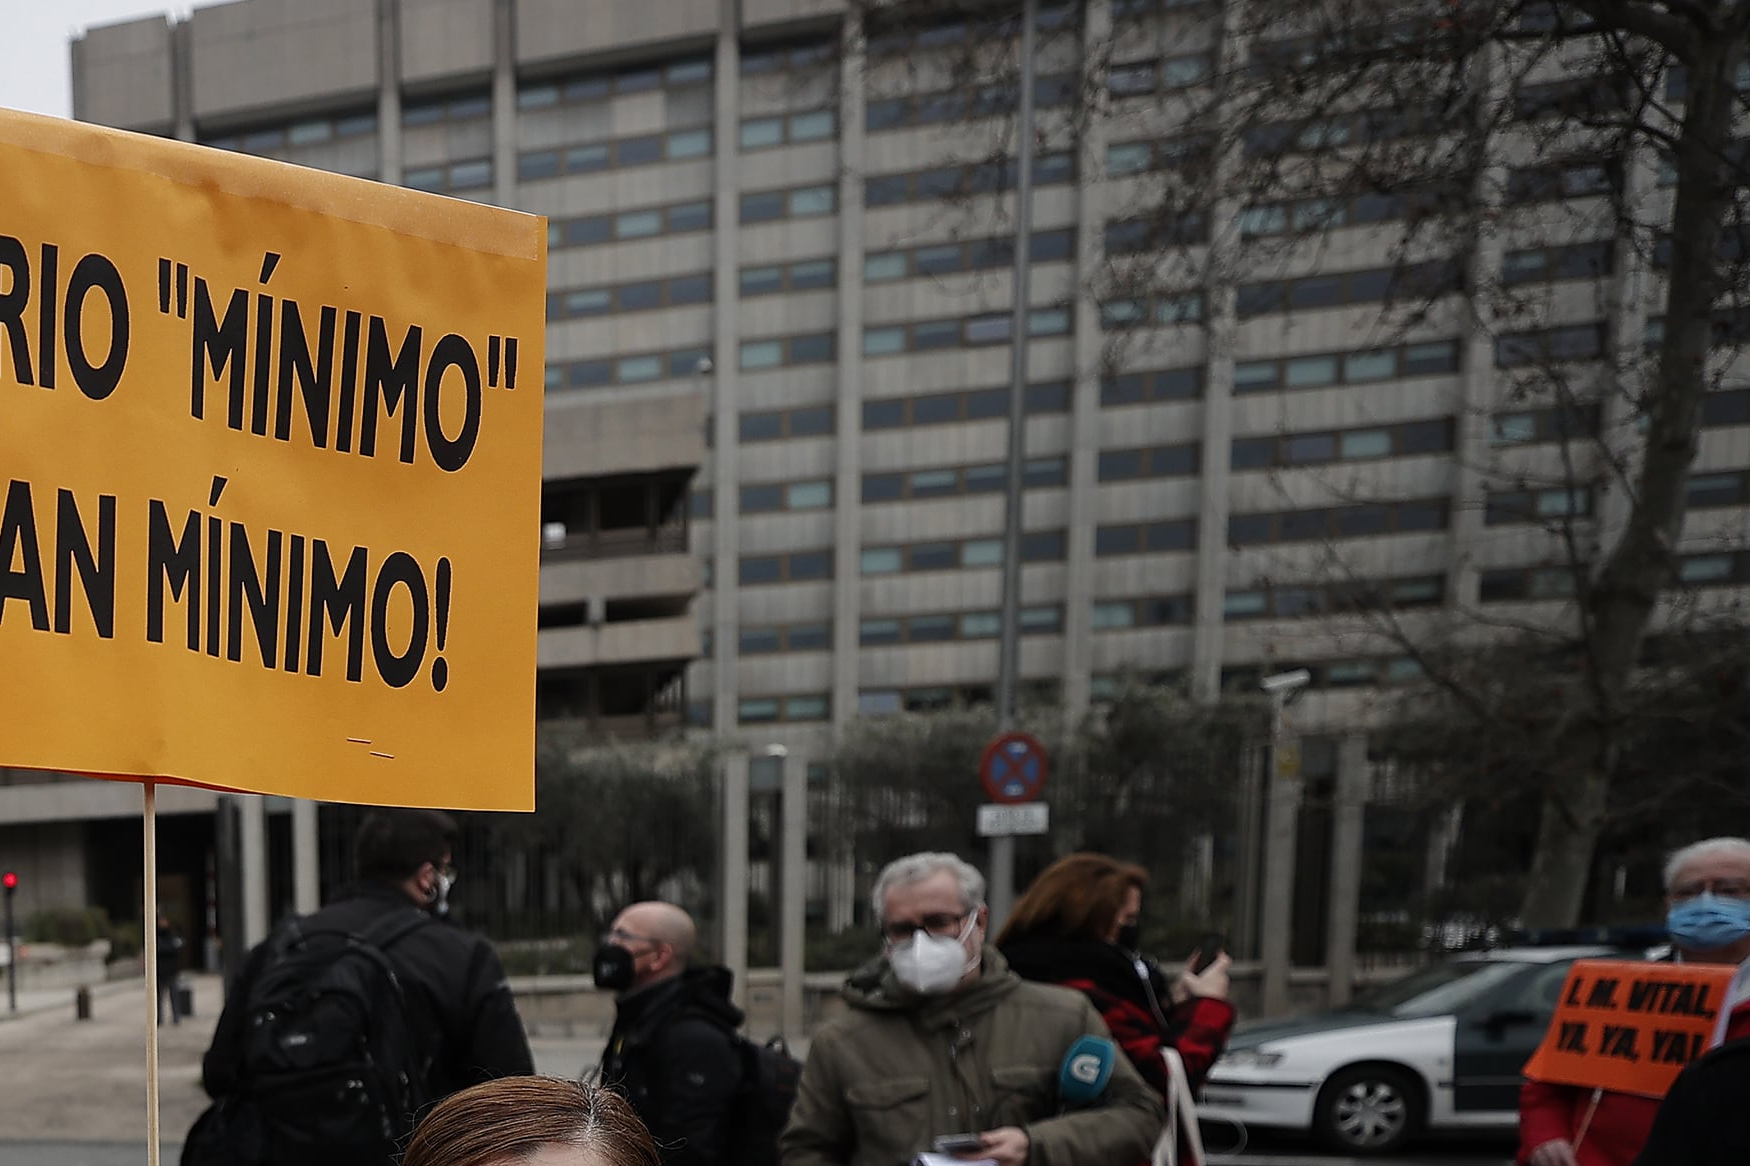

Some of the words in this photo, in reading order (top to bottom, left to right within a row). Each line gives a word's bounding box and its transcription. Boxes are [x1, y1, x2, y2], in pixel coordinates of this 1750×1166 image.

[158, 251, 519, 473] "MÍNIMO"
[147, 475, 452, 693] MÍNIMO!
[1626, 979, 1717, 1021] VITAL,
